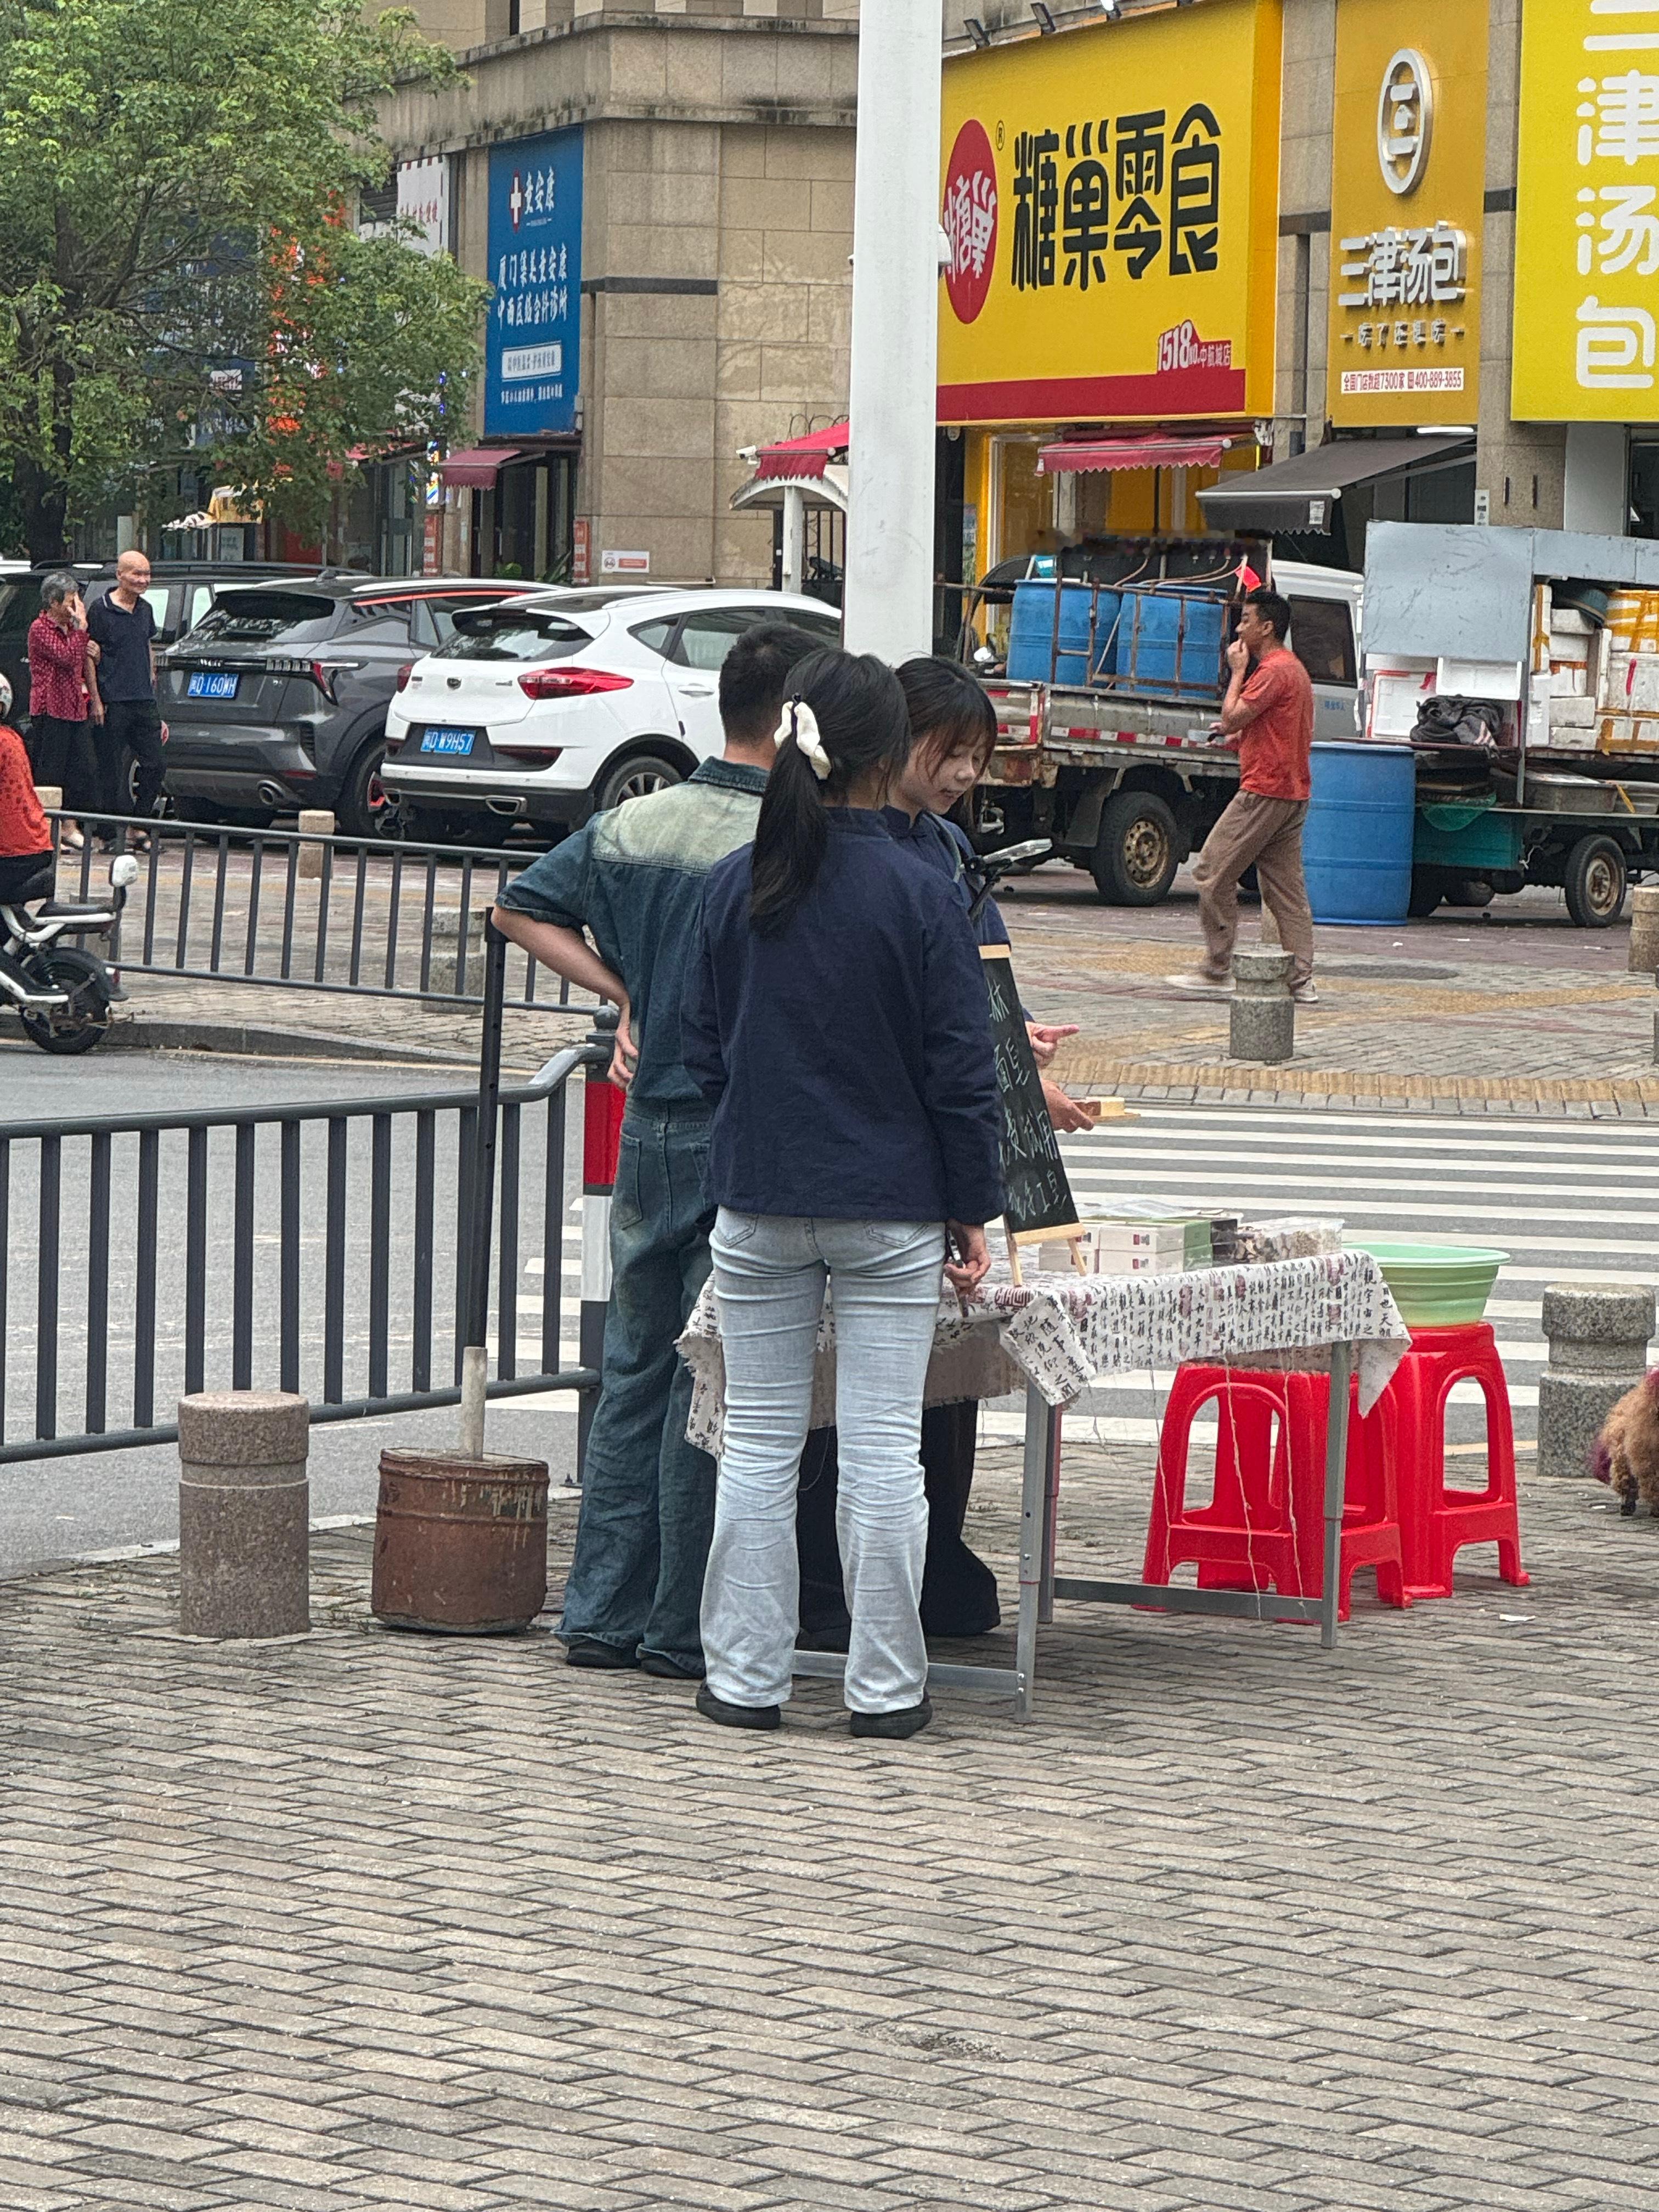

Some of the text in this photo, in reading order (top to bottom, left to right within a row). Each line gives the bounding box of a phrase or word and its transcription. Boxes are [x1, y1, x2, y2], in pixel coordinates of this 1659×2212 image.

[1339, 220, 1464, 306] 三津汤包
[1576, 0, 1659, 388] 三津汤包
